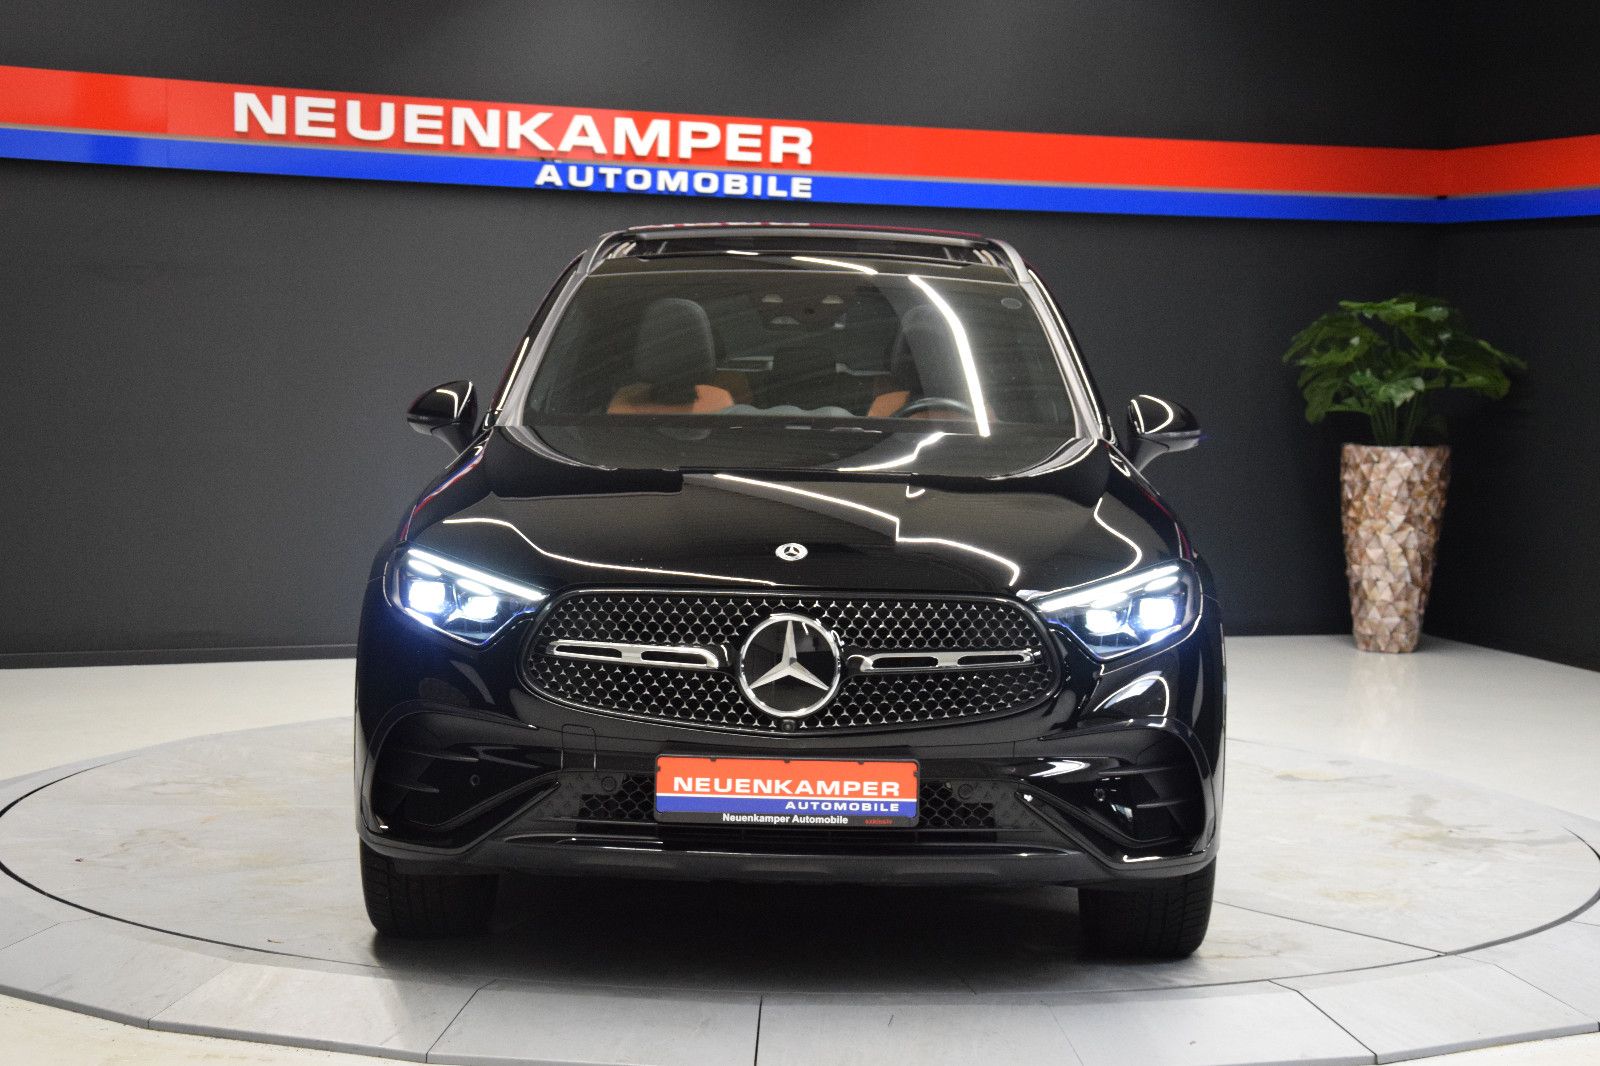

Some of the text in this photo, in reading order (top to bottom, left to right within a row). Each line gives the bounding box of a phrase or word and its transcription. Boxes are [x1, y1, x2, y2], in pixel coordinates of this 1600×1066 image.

[233, 91, 814, 166] NEUENKAMPER
[535, 164, 813, 198] AUTOMOBILE
[673, 777, 900, 796] NEUENKAMPER
[785, 801, 900, 812] AUTOMOBILE
[722, 813, 849, 825] Neuenkamper Automobile
